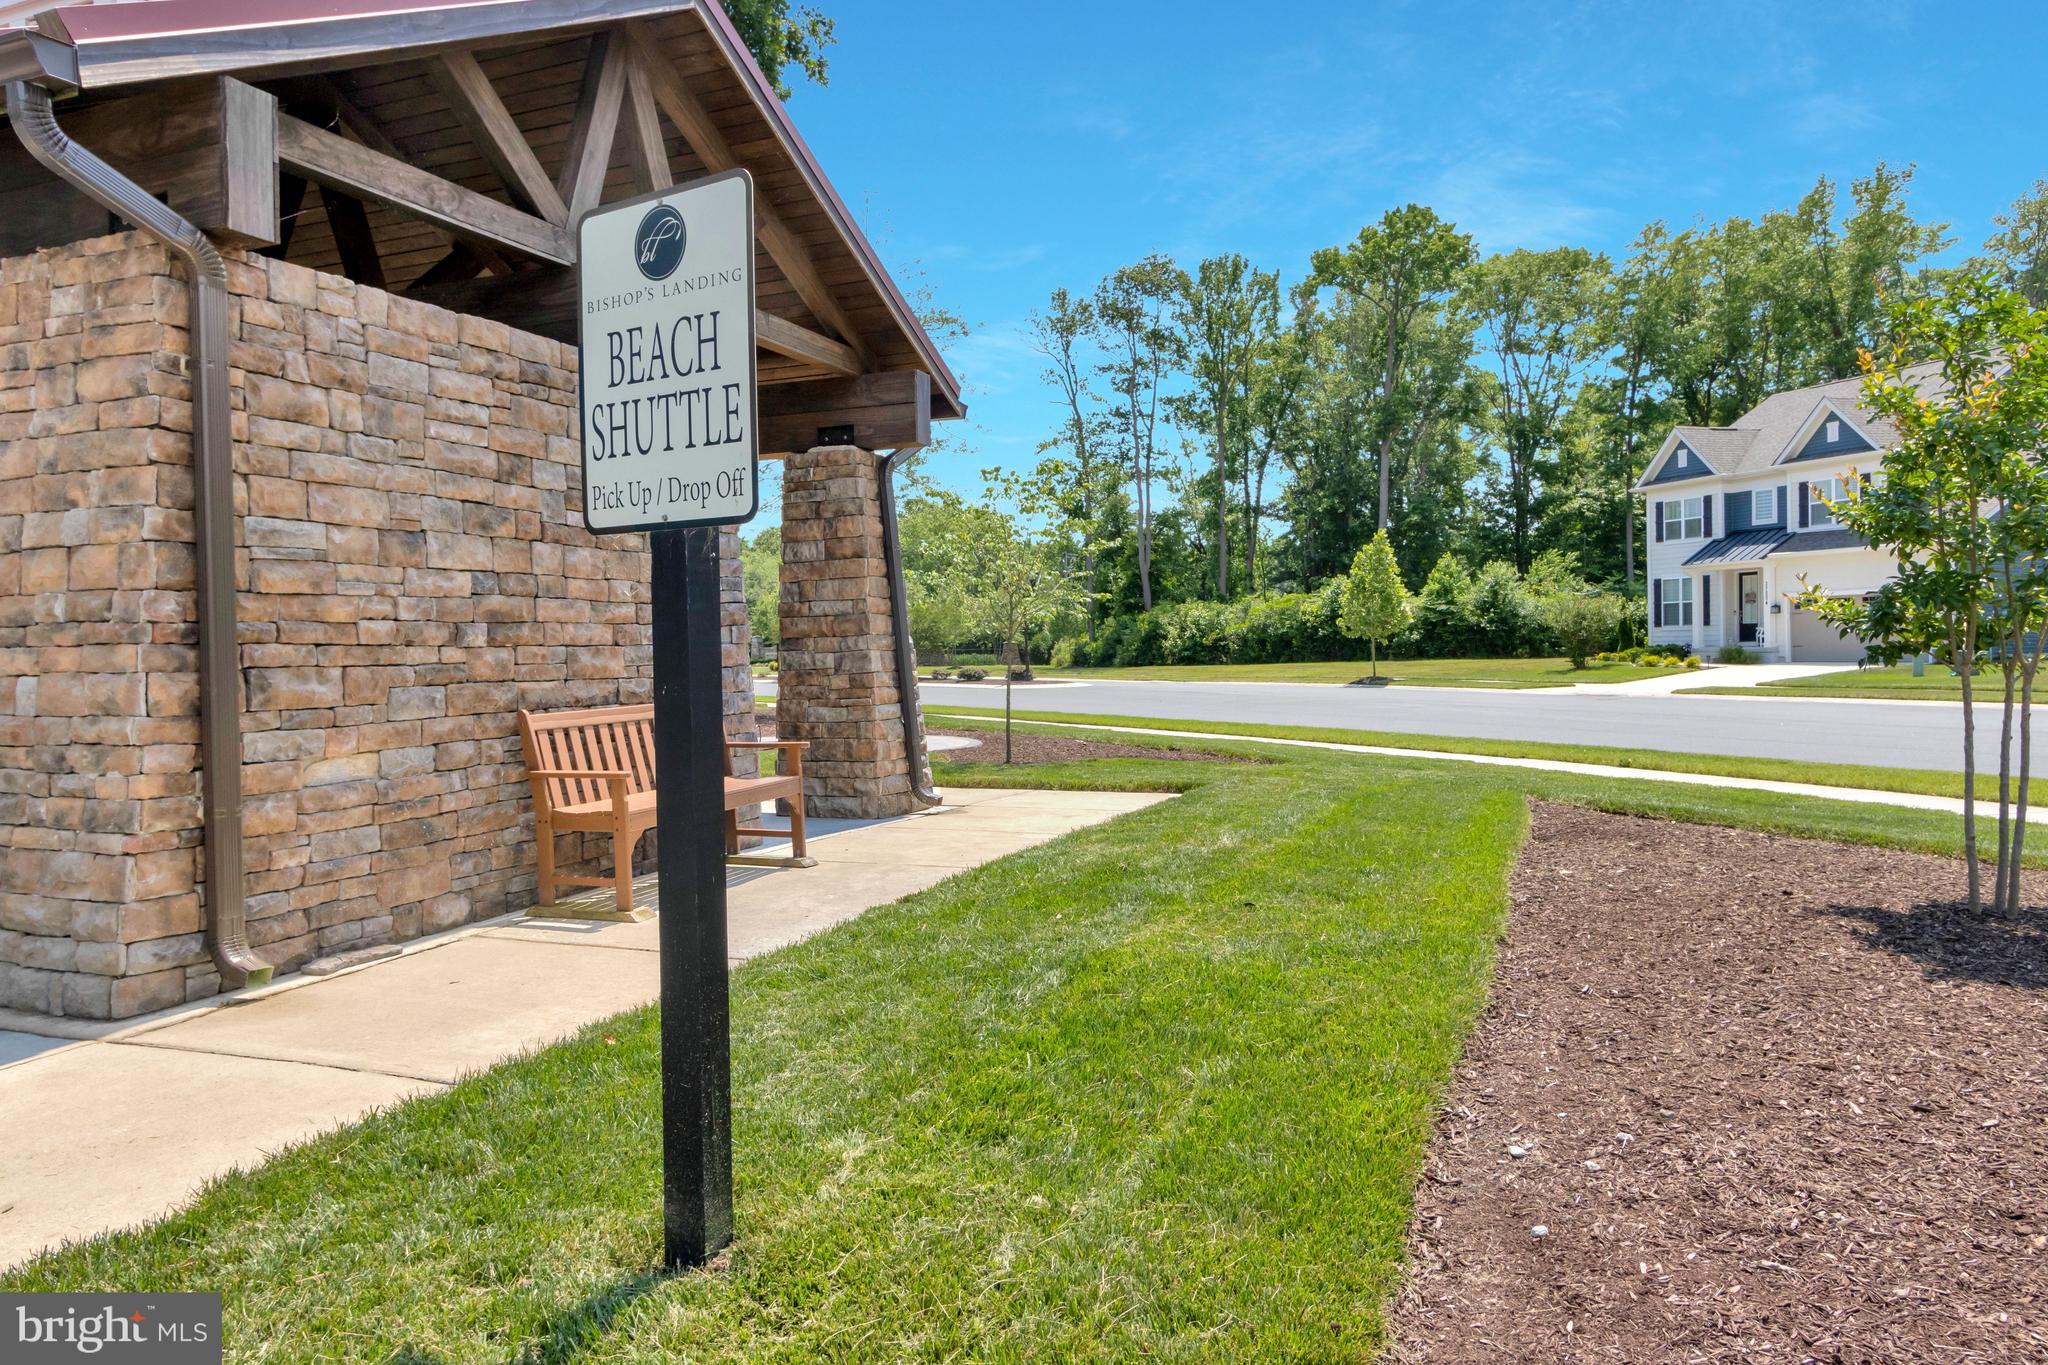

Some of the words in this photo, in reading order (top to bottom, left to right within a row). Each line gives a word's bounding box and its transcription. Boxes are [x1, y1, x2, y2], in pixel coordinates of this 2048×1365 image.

[587, 286, 654, 314] BISHOP'S
[663, 268, 742, 297] LANDING
[607, 310, 721, 388] BEACH
[592, 383, 743, 461] SHUTTLE
[592, 482, 624, 511] Pick
[628, 481, 652, 514] Up
[668, 477, 711, 509] Drop
[716, 467, 746, 499] Off
